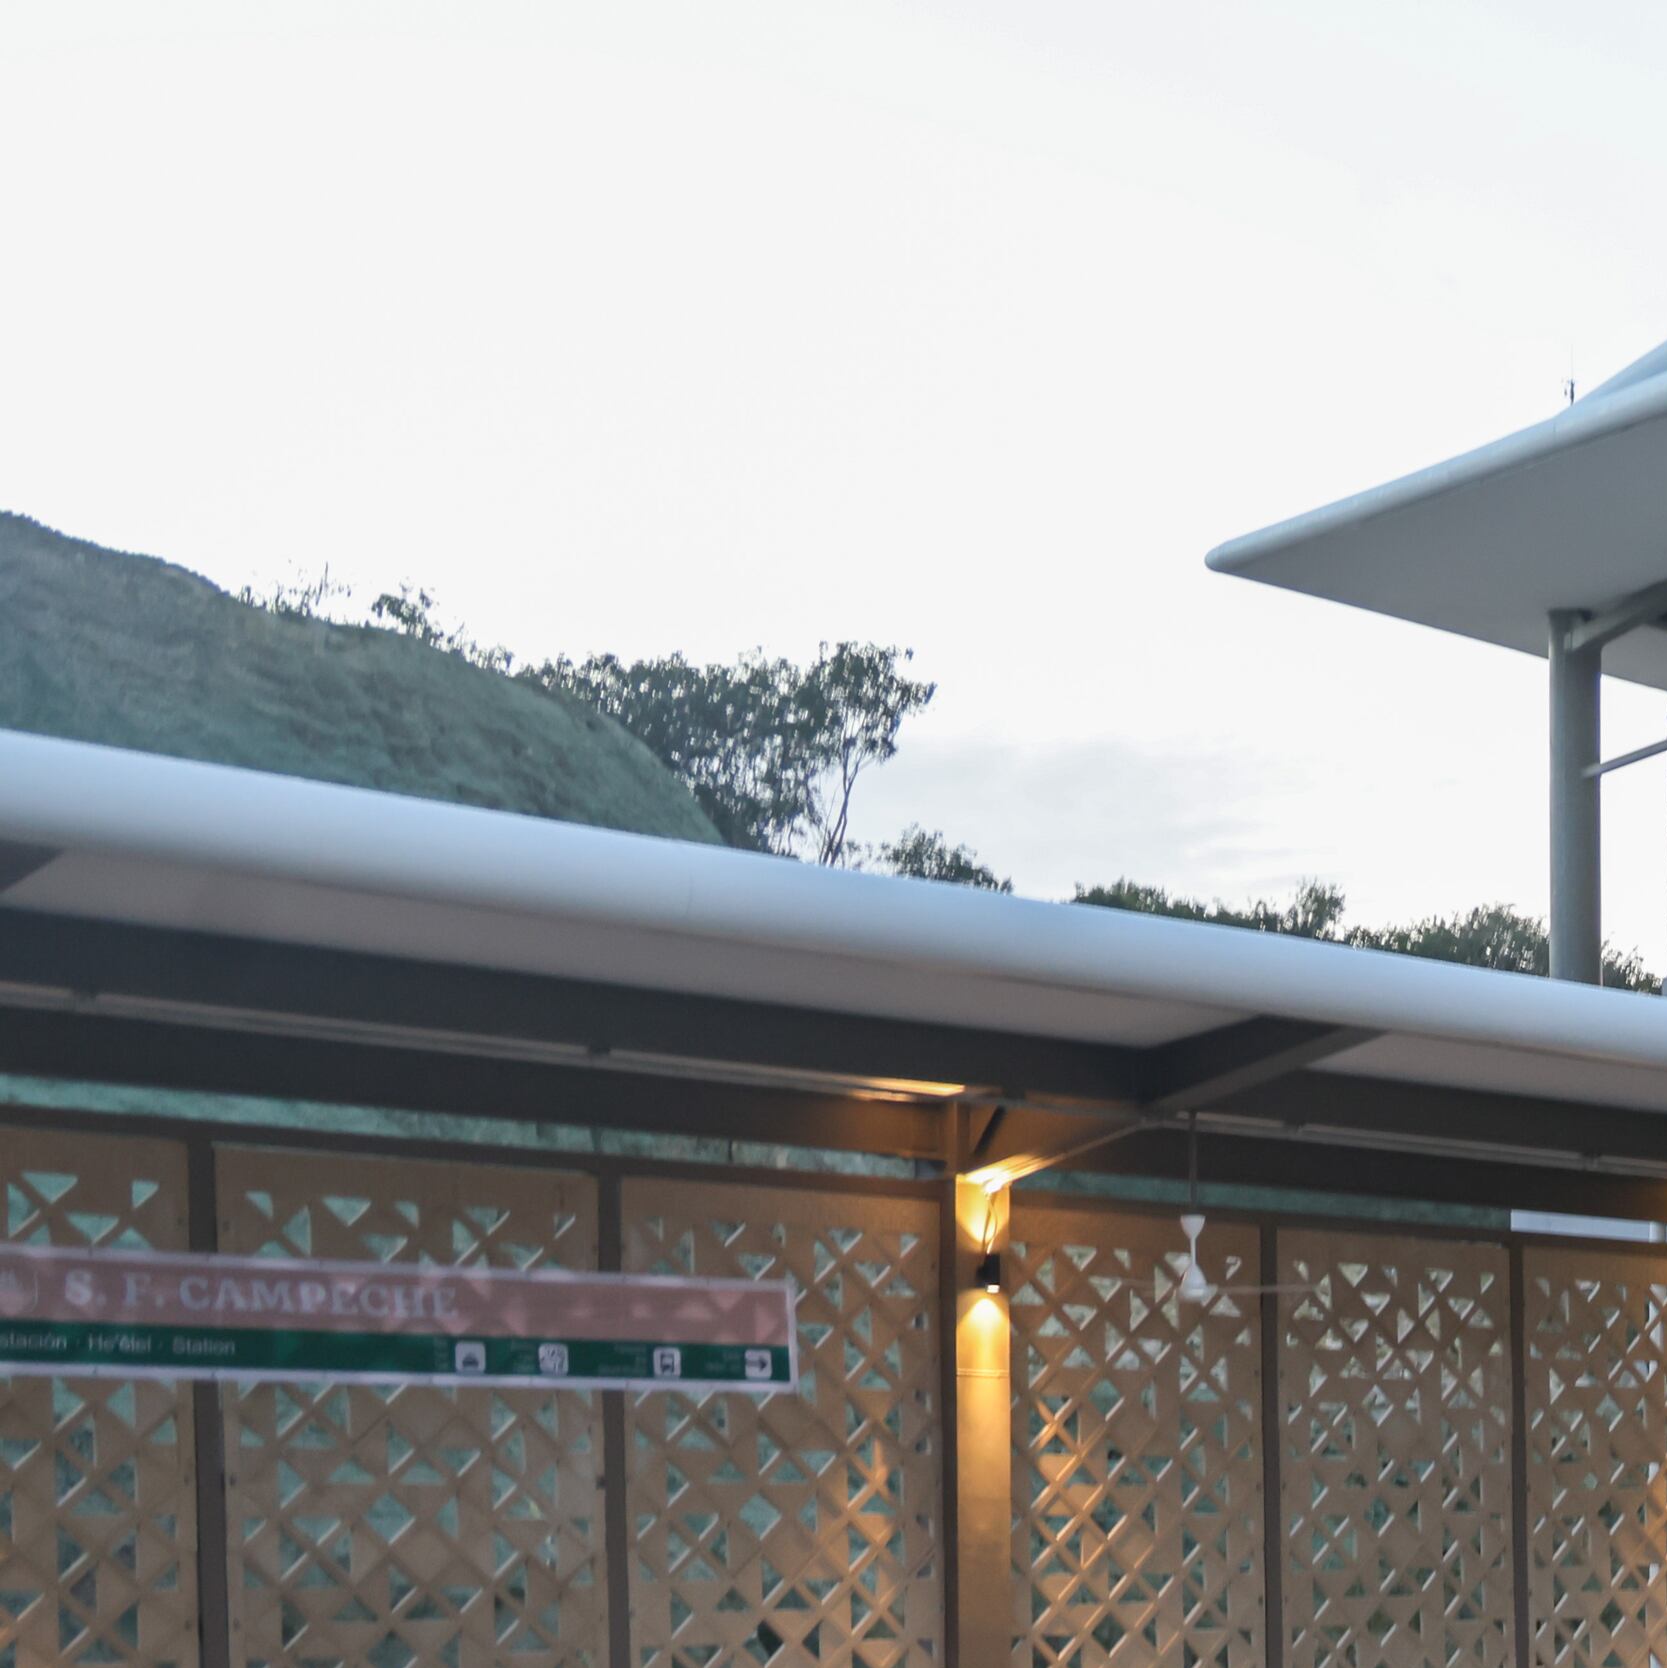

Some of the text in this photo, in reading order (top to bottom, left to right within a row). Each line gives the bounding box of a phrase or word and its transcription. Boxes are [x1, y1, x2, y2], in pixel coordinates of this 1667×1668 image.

[64, 1268, 458, 1320] S. F. CAMPECHE
